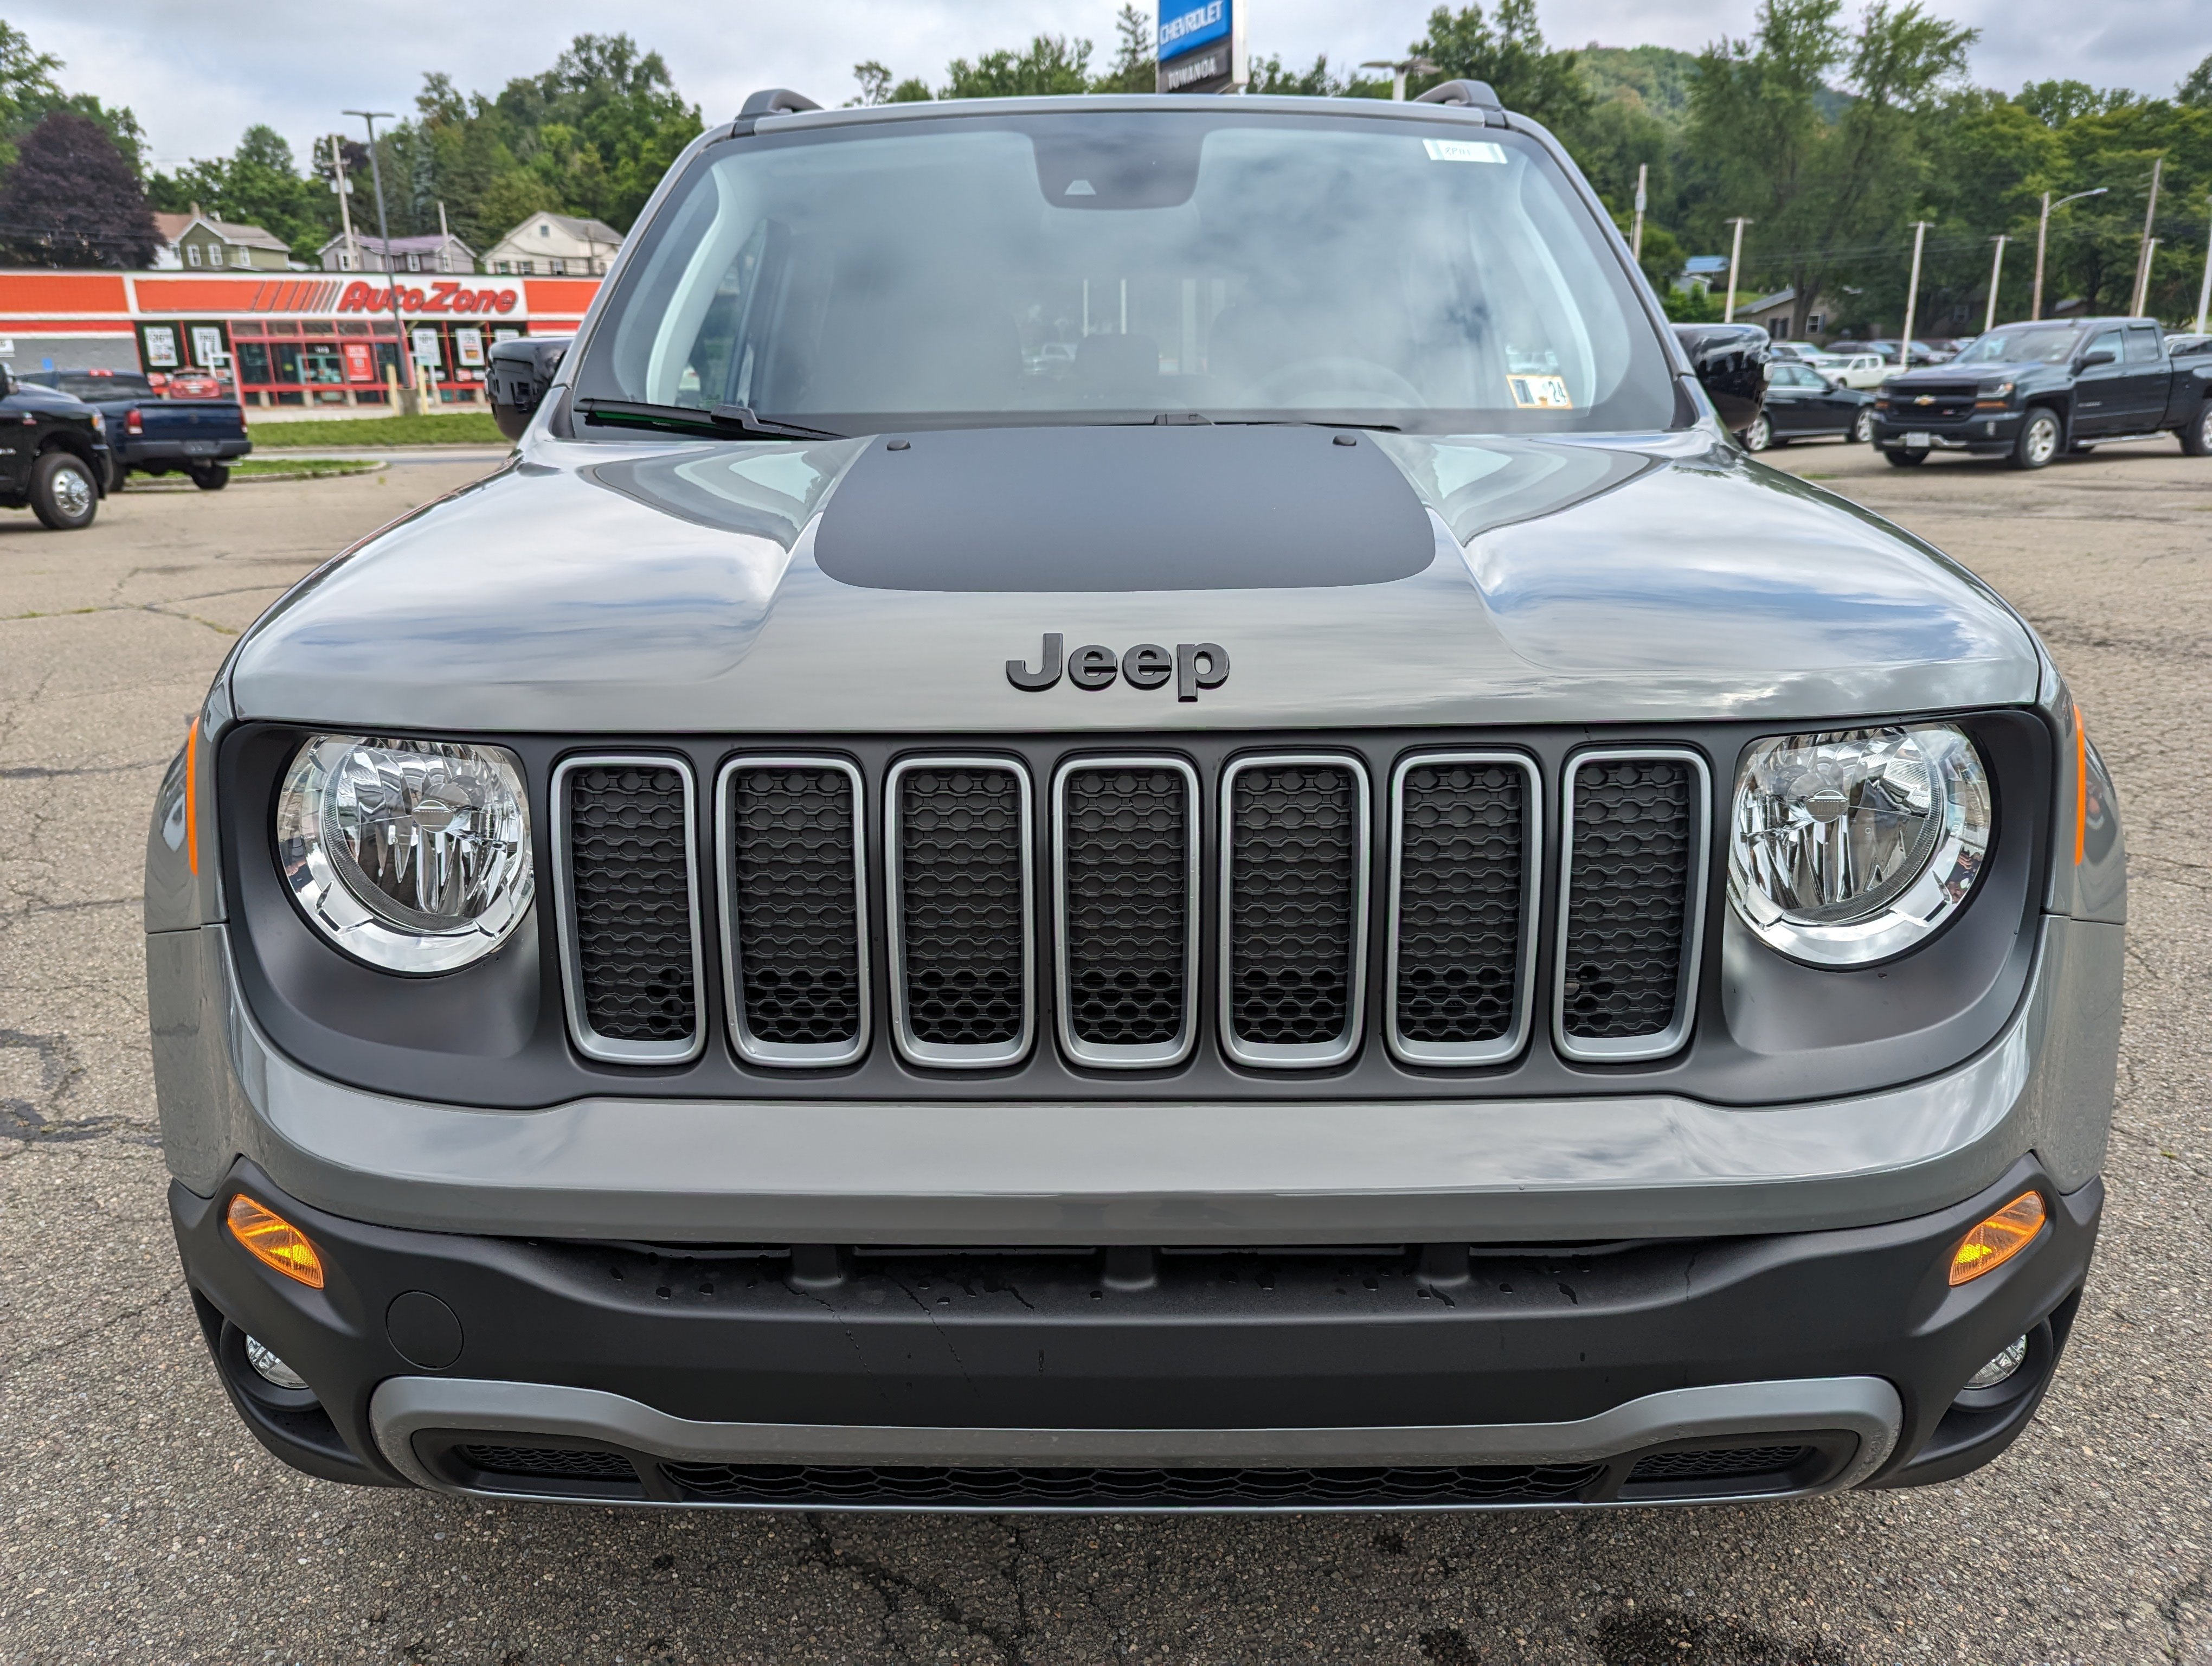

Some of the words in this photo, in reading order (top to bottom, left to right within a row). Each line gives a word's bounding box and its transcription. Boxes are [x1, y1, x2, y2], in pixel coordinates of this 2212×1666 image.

[1160, 1, 1223, 46] CHEVROLET
[1168, 56, 1217, 91] TOWANDA
[337, 281, 517, 313] AutoZone
[1006, 633, 1230, 703] Jeep
